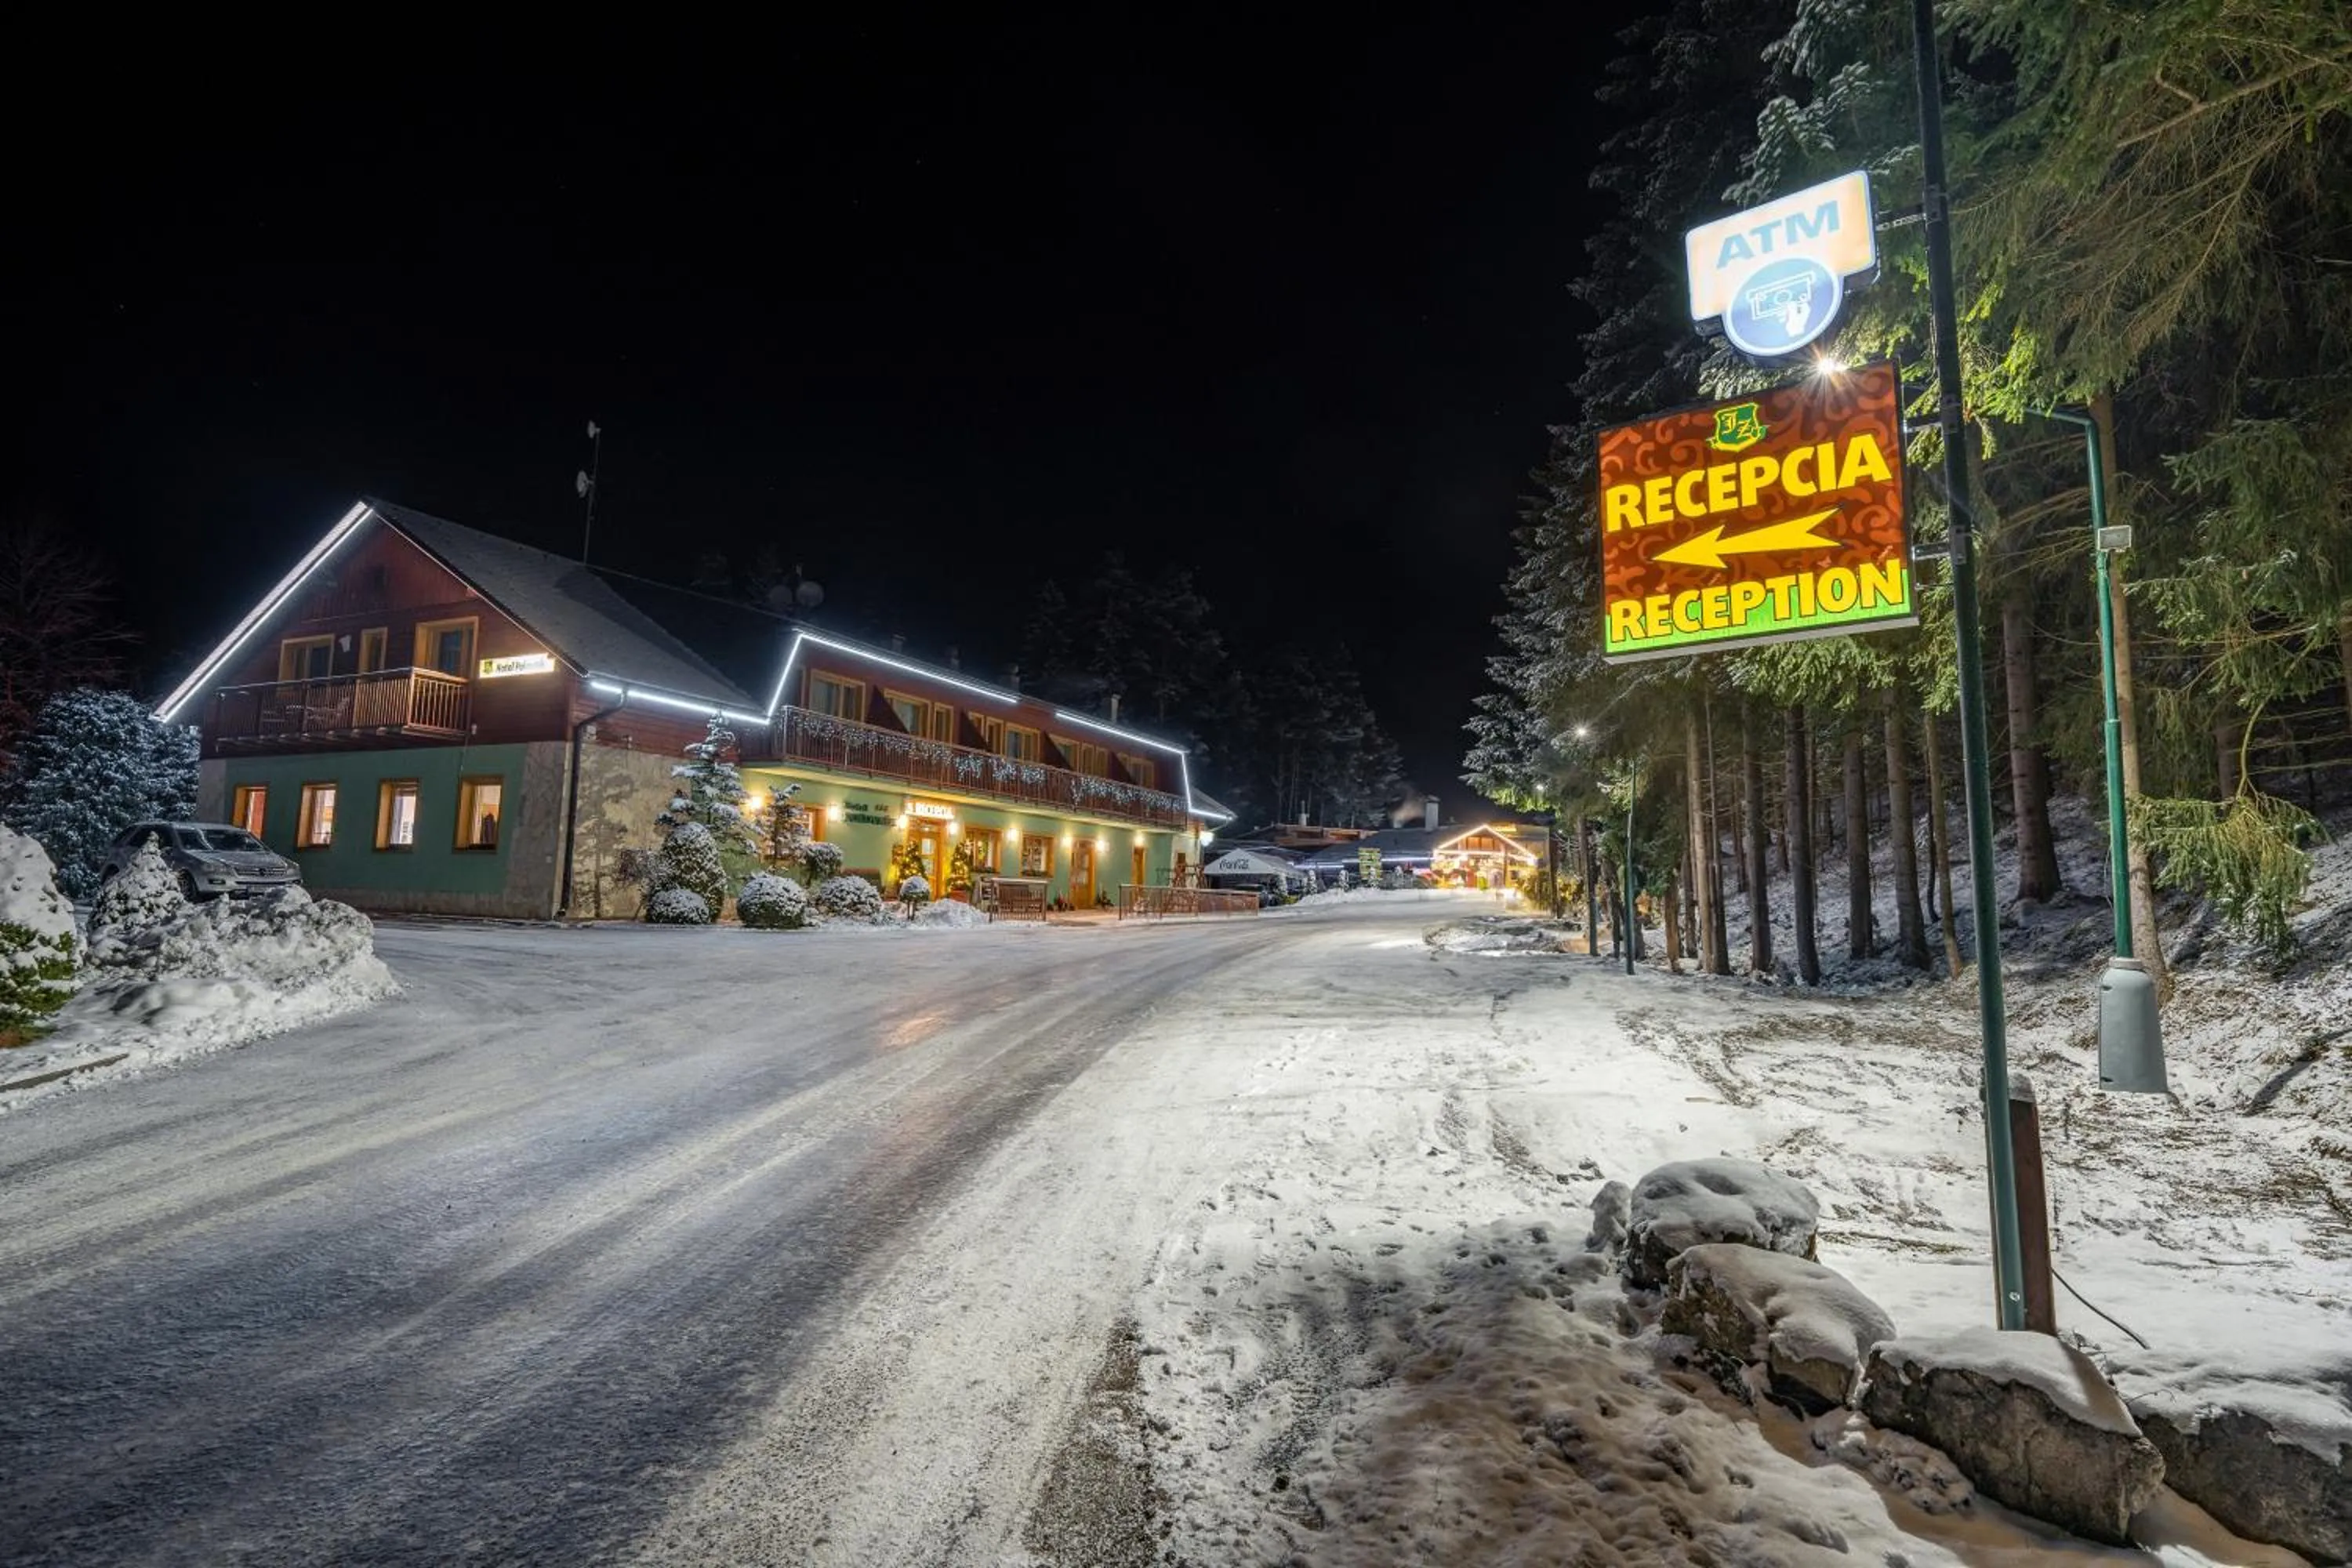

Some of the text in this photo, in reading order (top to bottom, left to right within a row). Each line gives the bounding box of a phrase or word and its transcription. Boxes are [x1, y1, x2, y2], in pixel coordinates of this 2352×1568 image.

[1716, 200, 1841, 269] ATM
[1605, 434, 1893, 533] RECEPCIA
[1610, 558, 1905, 642] RECEPTION
